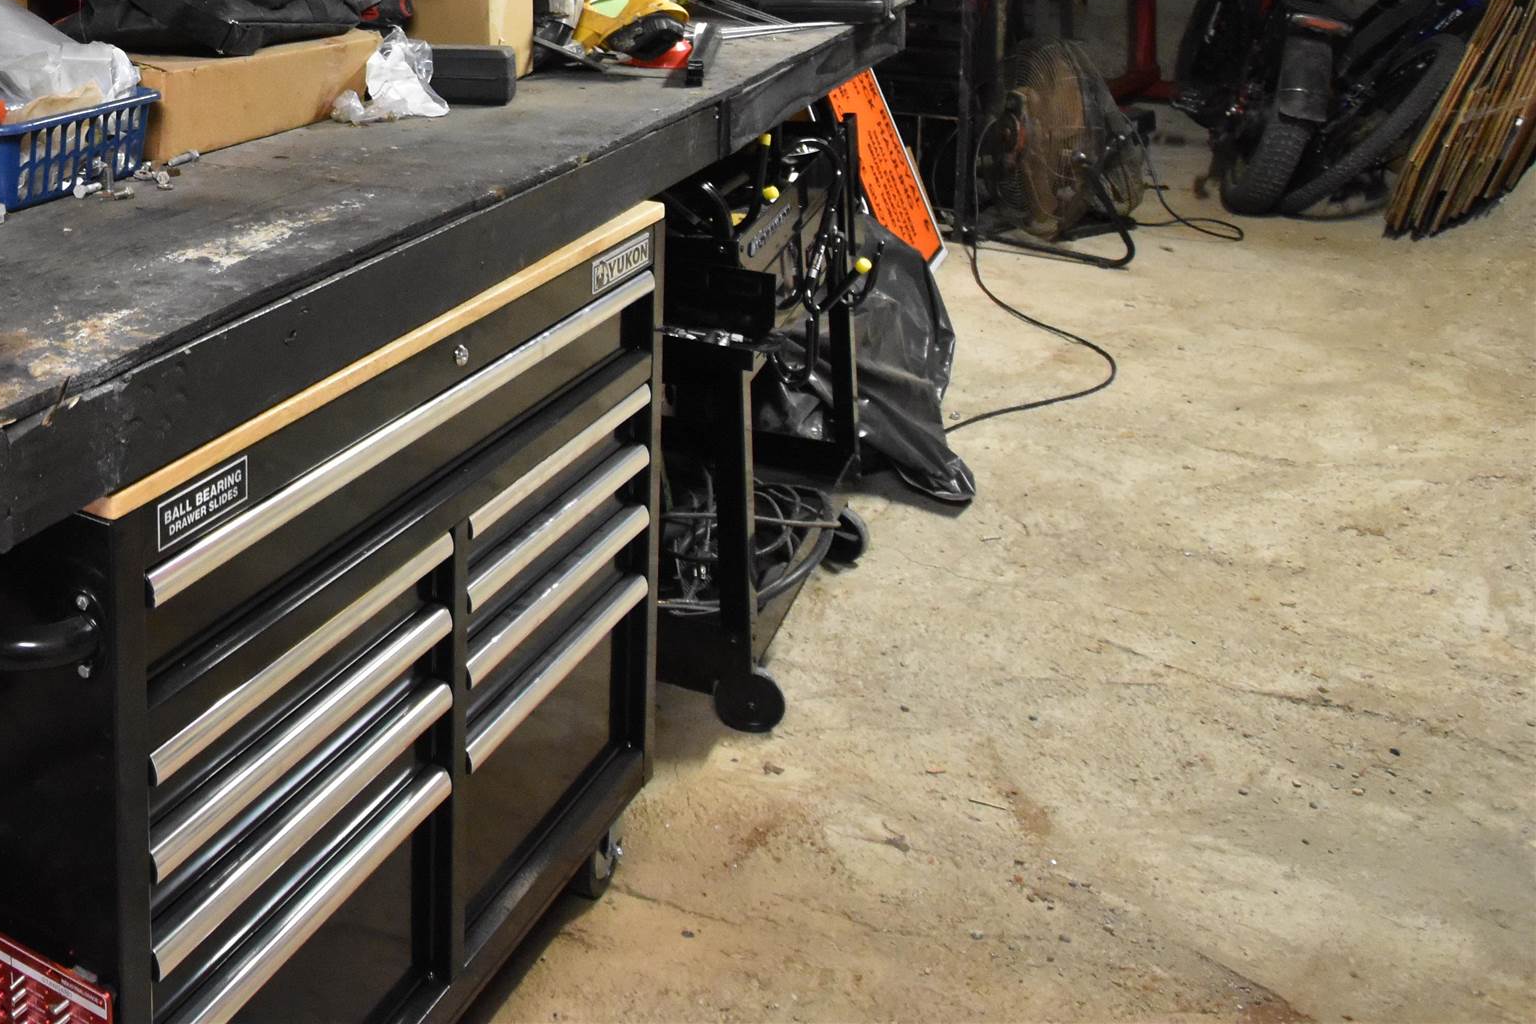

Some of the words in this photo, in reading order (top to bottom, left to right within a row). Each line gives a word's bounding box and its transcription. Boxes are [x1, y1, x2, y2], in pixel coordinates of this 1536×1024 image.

[874, 120, 916, 210] HAULING
[878, 108, 922, 207] REMOVAL
[608, 242, 648, 278] YUKON
[164, 499, 192, 525] BALL
[196, 470, 242, 506] BEARING
[169, 506, 207, 536] DRAWER
[209, 486, 239, 512] SLIDES
